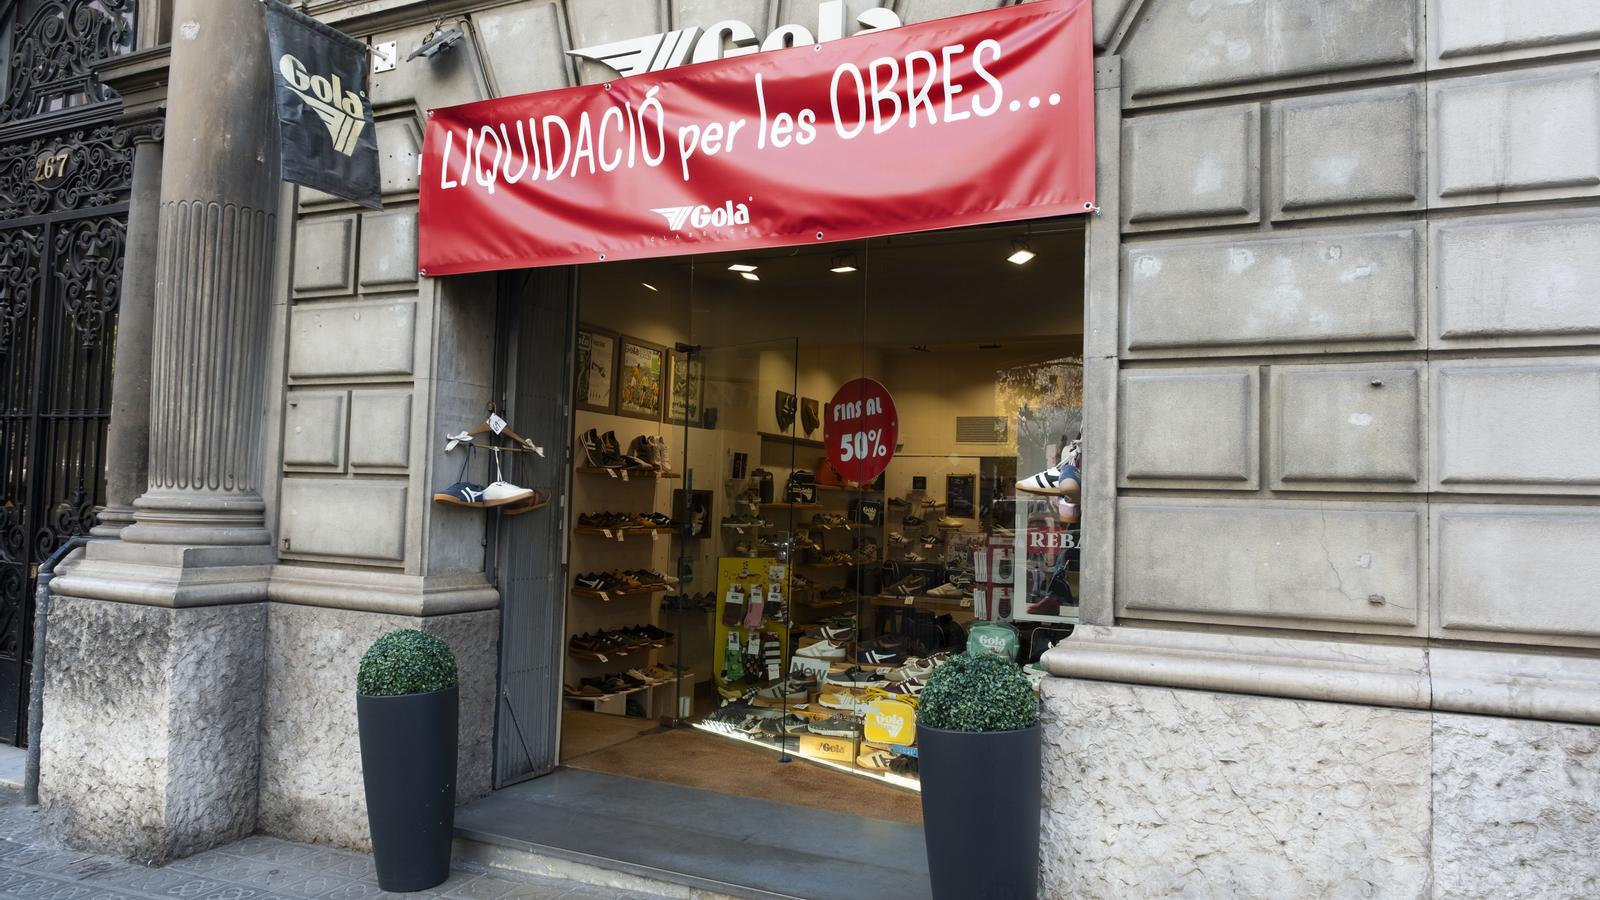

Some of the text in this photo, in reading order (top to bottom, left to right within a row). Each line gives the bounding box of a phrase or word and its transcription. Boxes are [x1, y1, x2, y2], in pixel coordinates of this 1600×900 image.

[279, 53, 364, 119] Gola
[441, 39, 1061, 195] LIQUIDACIÓ per les OBRES...
[35, 153, 69, 182] 267
[690, 200, 750, 229] Gola
[833, 396, 883, 422] FINS AL
[840, 428, 887, 463] 50%
[978, 634, 1007, 647] Gola
[792, 662, 827, 681] New
